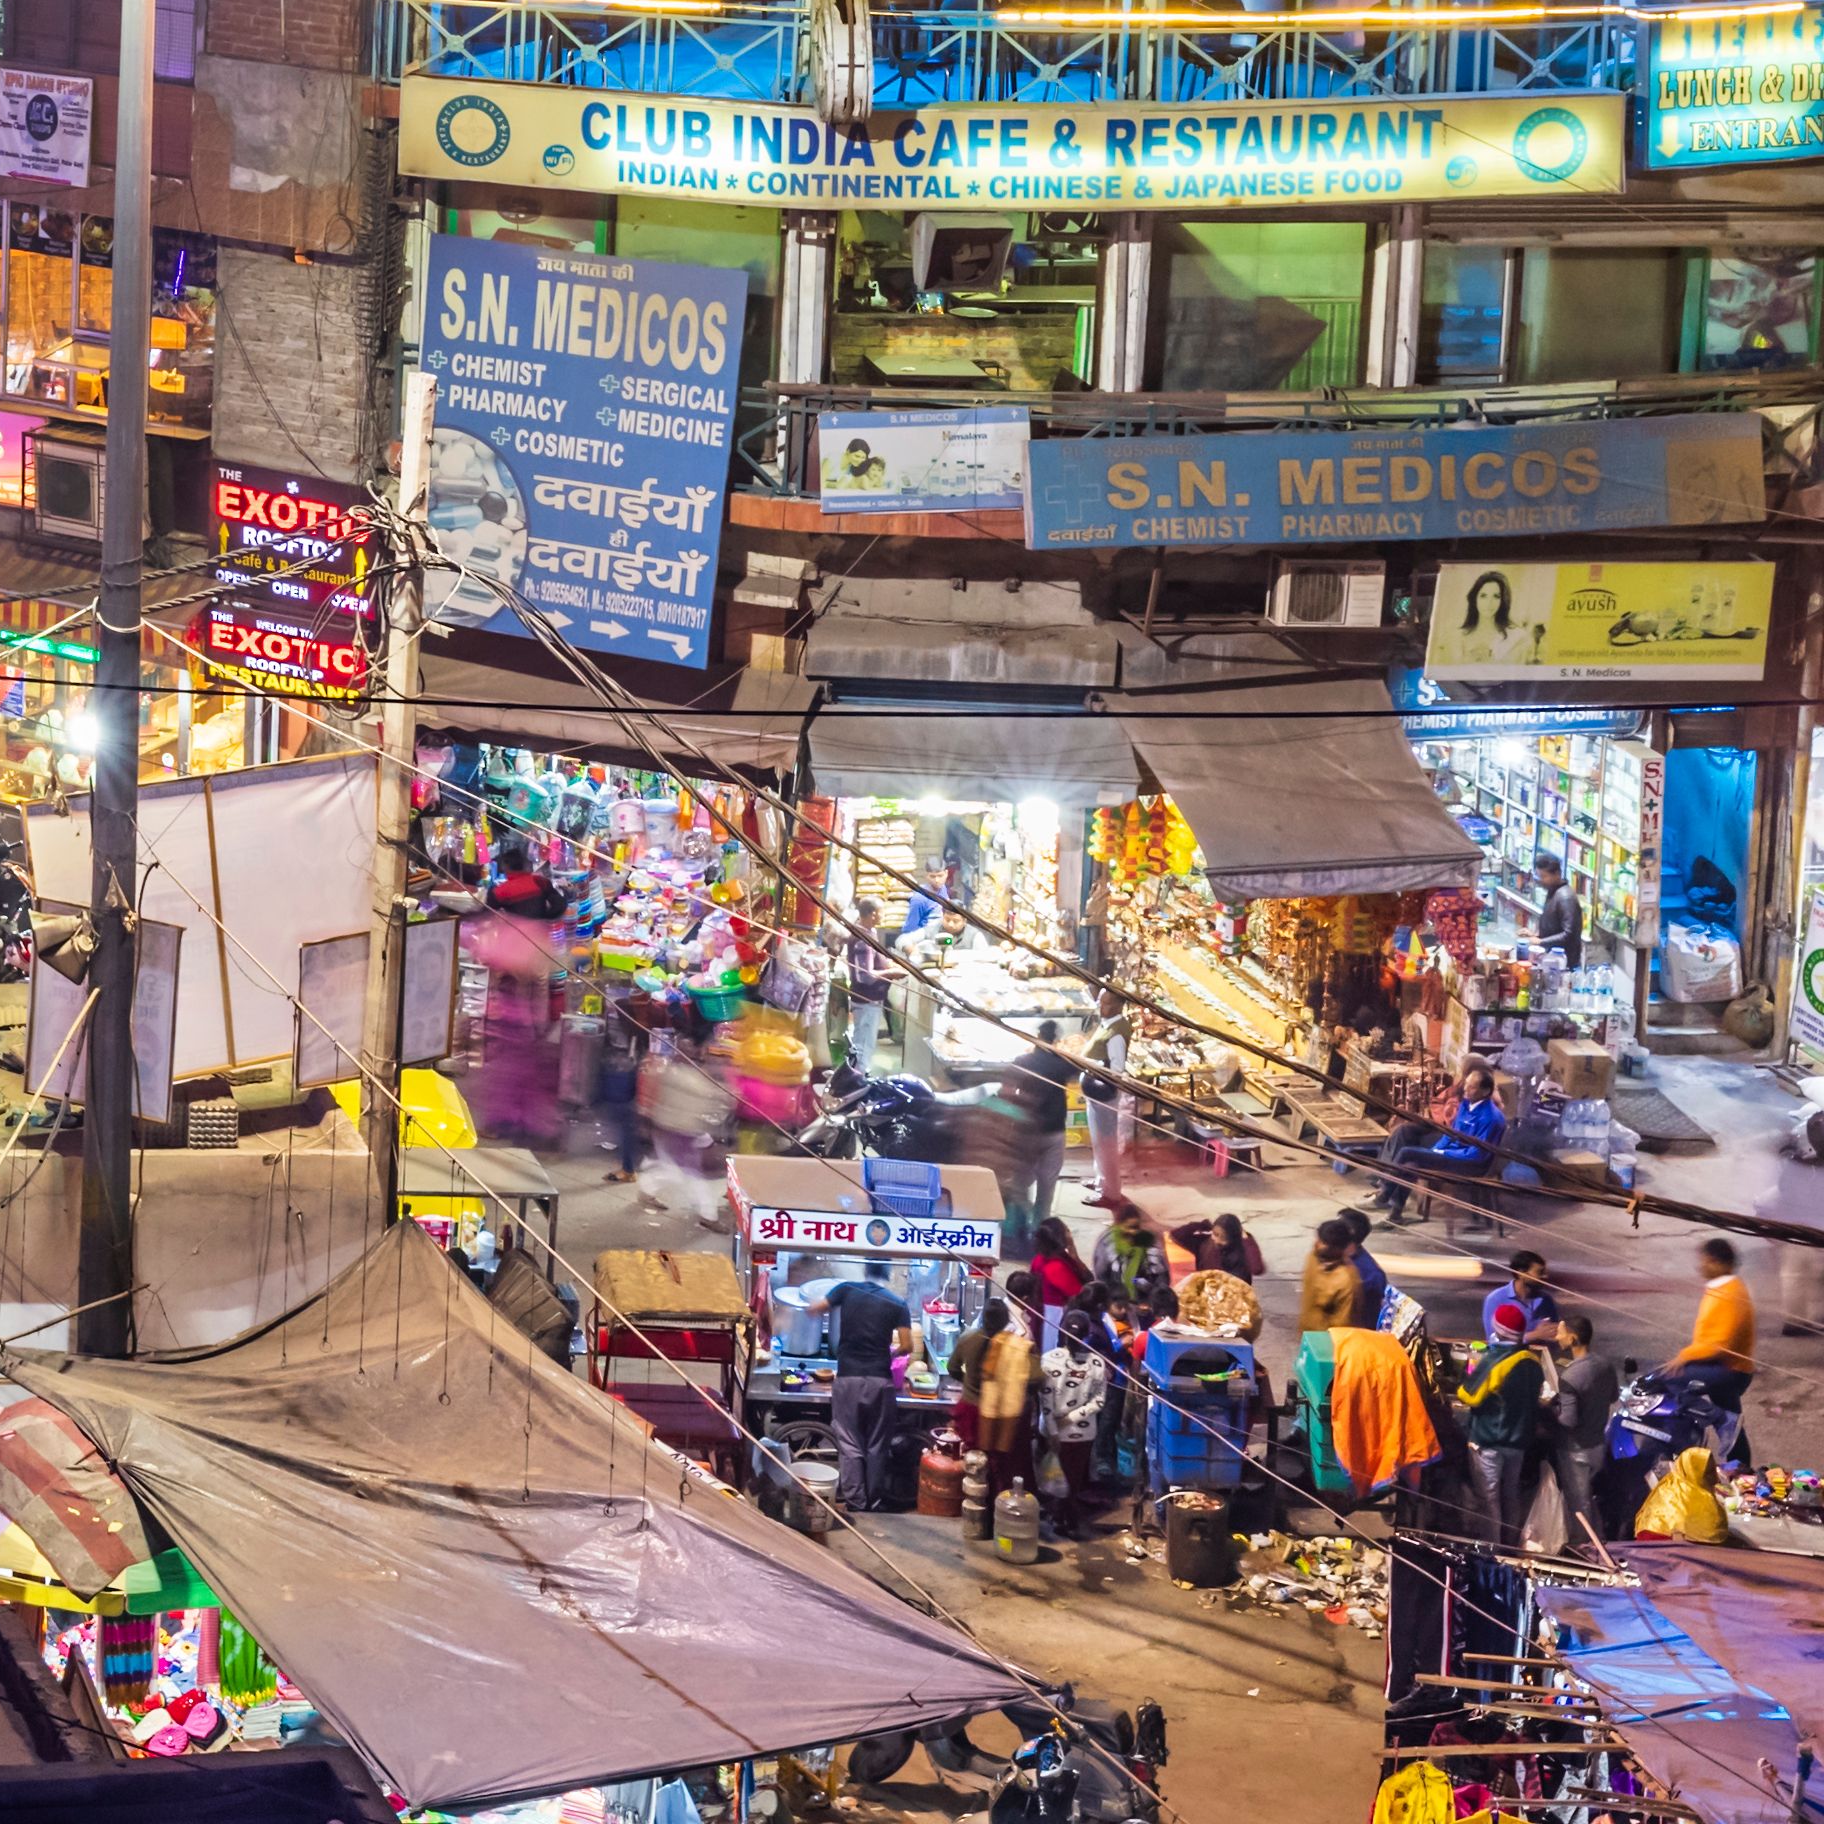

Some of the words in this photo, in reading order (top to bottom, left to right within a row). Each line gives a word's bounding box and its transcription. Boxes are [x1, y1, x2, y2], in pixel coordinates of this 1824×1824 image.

[1658, 66, 1752, 110] LUNCH
[1760, 65, 1784, 103] &
[581, 101, 711, 155] CLUB
[734, 113, 873, 166] INDIA
[895, 118, 1027, 169] CAFE
[1050, 119, 1082, 167] &
[1106, 108, 1443, 167] RESTAURANT
[619, 160, 717, 189] INDIAN
[747, 173, 959, 199] CONTINENTAL
[989, 174, 1122, 200] CHINESE
[1133, 175, 1152, 199] &
[1165, 172, 1318, 199] JAPANESE
[1325, 167, 1402, 194] FOOD
[537, 257, 565, 273] जय
[570, 259, 607, 278] माता
[611, 263, 633, 281] की
[441, 268, 518, 346] S.N.
[533, 279, 727, 375] MEDICOS
[452, 353, 546, 387] CHEMIST
[449, 386, 567, 423] PHARMACY
[621, 376, 729, 414] SERGICAL
[617, 410, 724, 447] MEDICINE
[910, 413, 958, 422] MEDICOS
[515, 430, 624, 467] COSMETIC
[219, 468, 242, 481] THE
[1107, 460, 1250, 509] S.N.
[1279, 446, 1601, 507] MEDICOS
[533, 474, 717, 533] दवाईयाँ
[610, 531, 629, 549] ही
[1132, 516, 1250, 540] CHEMIST
[1281, 512, 1425, 538] PHARMACY
[1457, 505, 1581, 532] COSMETIC
[266, 558, 275, 571] &
[527, 537, 709, 597] दवाईयाँ
[273, 582, 308, 600] OPEN
[1567, 596, 1616, 612] ayush
[211, 611, 233, 623] THE
[211, 623, 365, 673] EXOTIC
[245, 657, 324, 680] ROOFTOP
[1586, 669, 1631, 677] Medicos
[758, 1211, 797, 1240] श्री
[803, 1221, 858, 1242] नाथ
[897, 1223, 993, 1249] आईस्क्रीम
